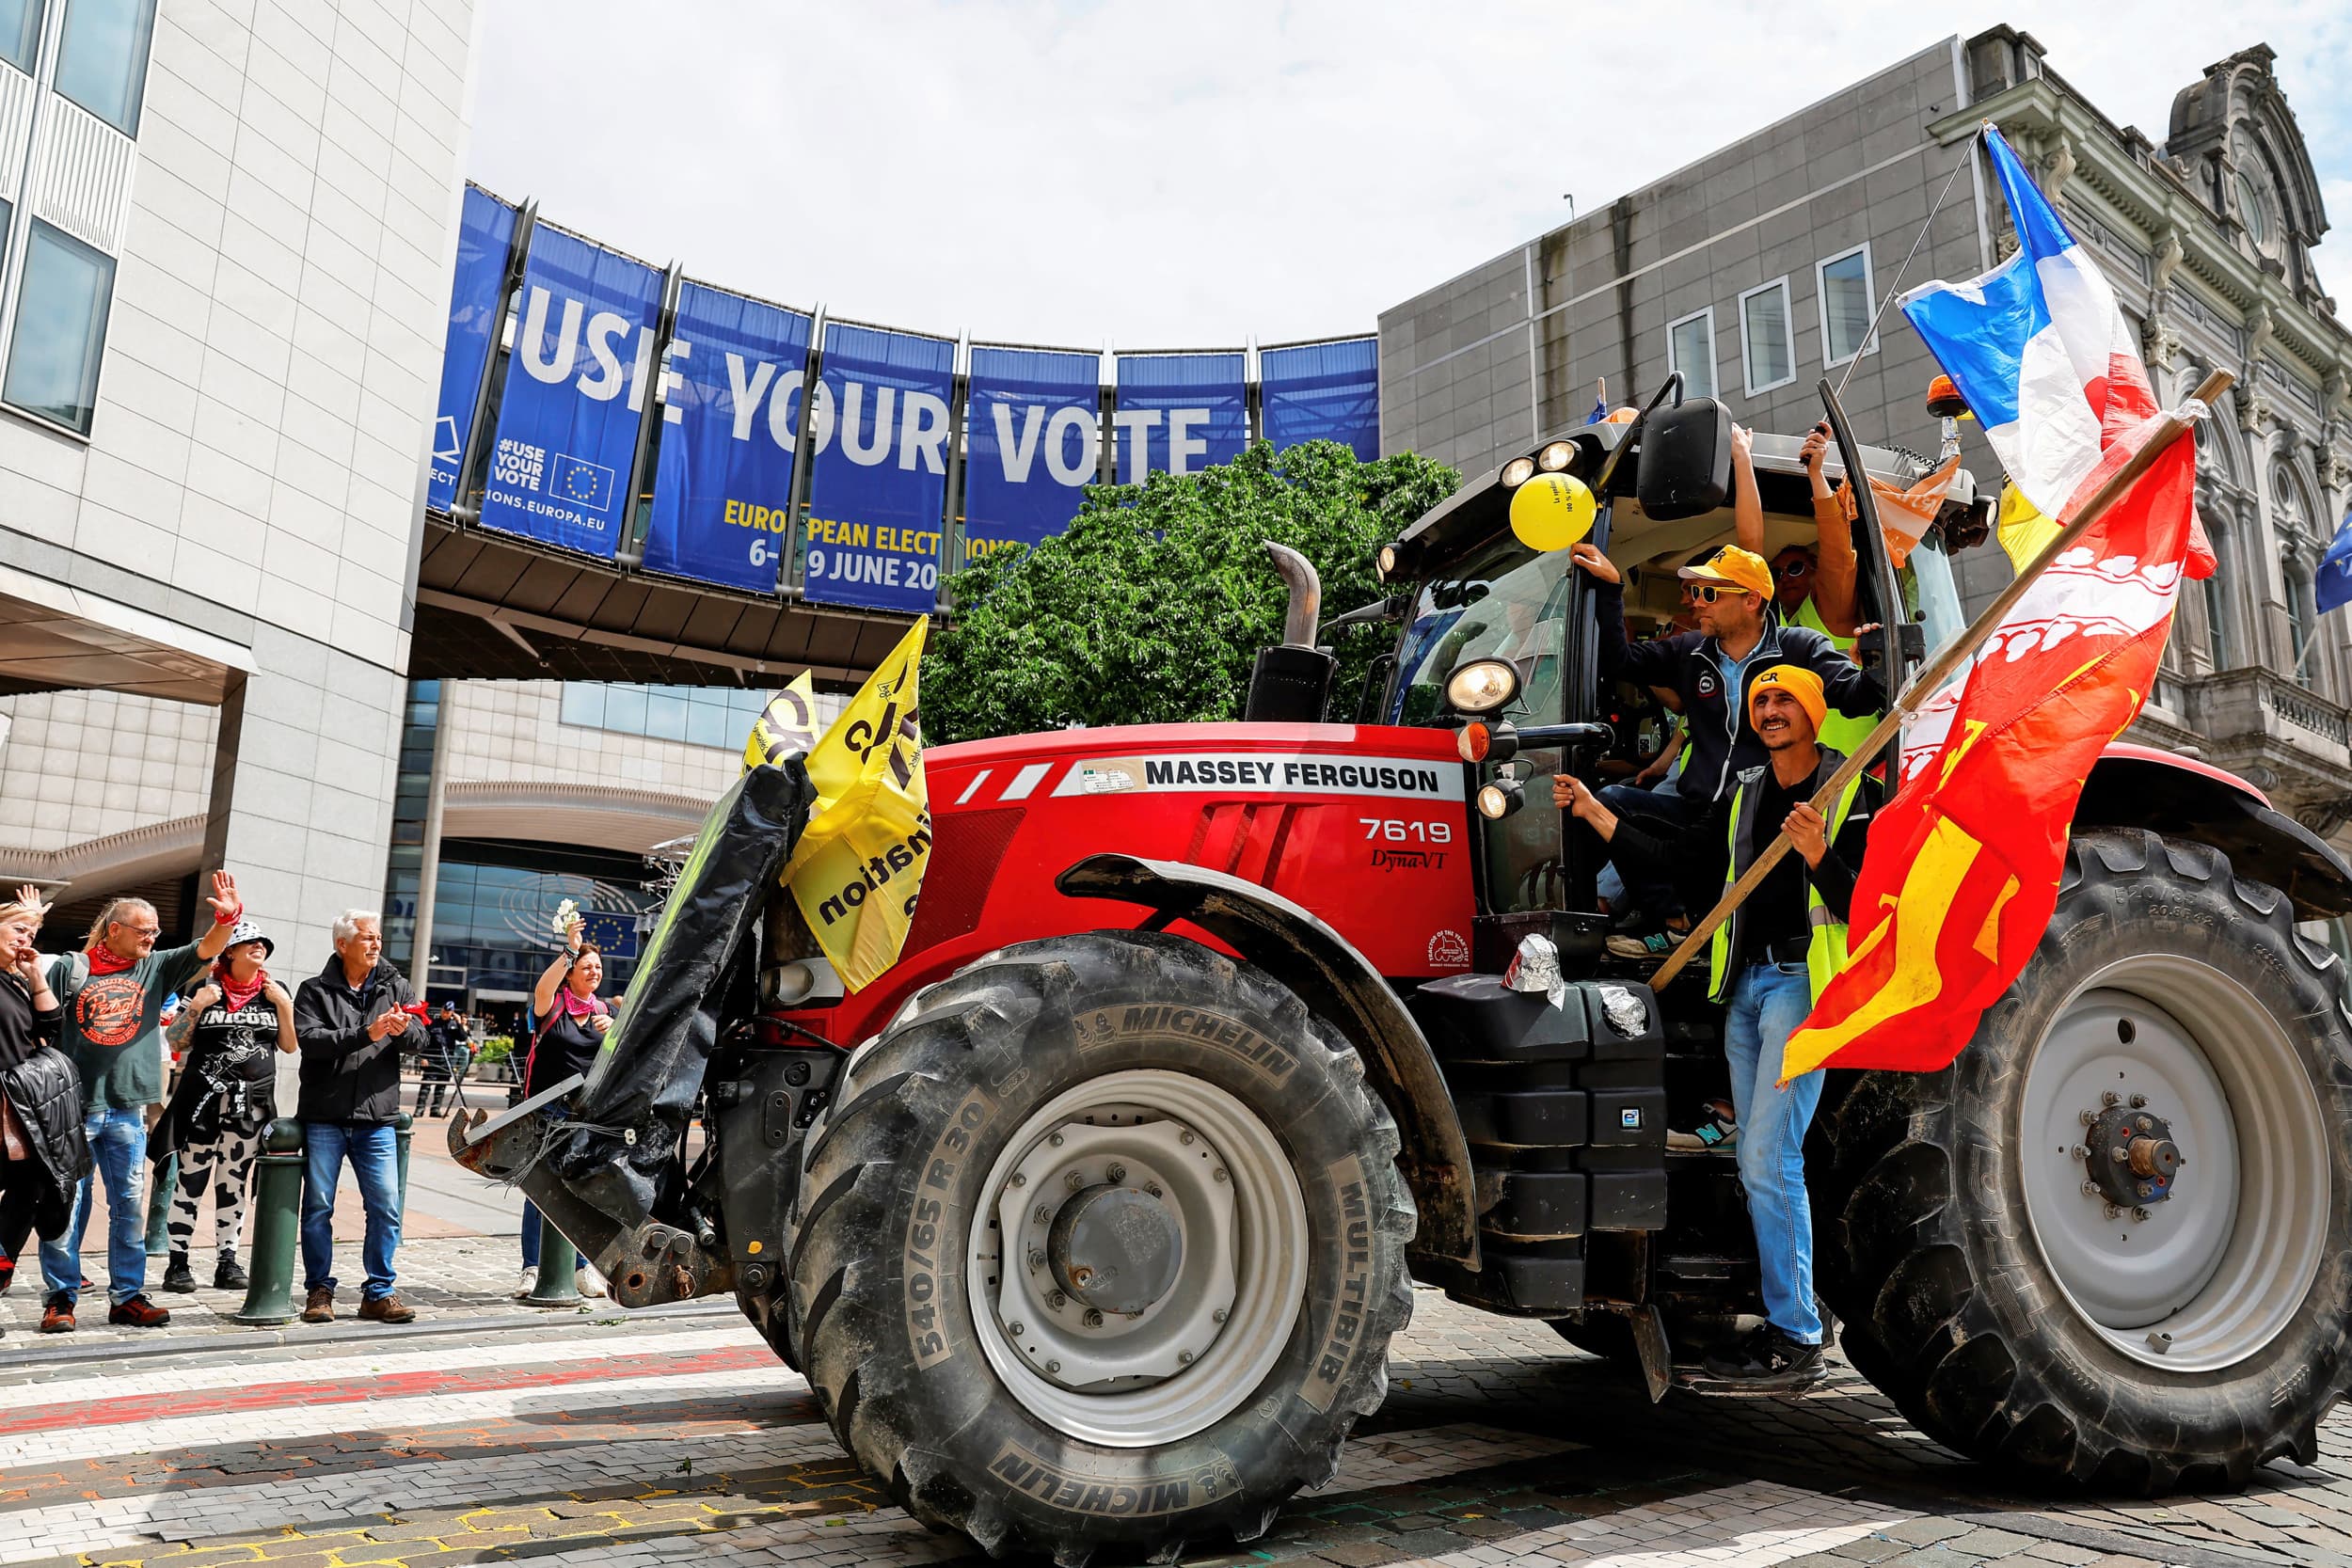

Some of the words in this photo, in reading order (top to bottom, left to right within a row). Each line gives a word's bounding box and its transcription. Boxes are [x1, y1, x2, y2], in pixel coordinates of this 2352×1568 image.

[520, 286, 691, 425] USE
[724, 352, 951, 474] YOUR
[993, 403, 1210, 487] VOTE
[497, 451, 544, 478] YOUR
[499, 438, 546, 462] #USE
[494, 467, 540, 492] VOTE
[829, 551, 899, 587] JUNE
[1760, 672, 1778, 683] CR
[1145, 760, 1274, 784] MASSEY
[1283, 762, 1439, 793] FERGUSON
[1359, 817, 1452, 844] 7619
[1371, 848, 1449, 873] Dyna-VT
[86, 991, 138, 1020] Petrol
[1123, 1006, 1295, 1079] MICHELIN
[943, 1101, 986, 1155] 30
[925, 1157, 956, 1192] R
[908, 1196, 945, 1359] 540/65
[1316, 1180, 1369, 1388] MULTIBIB
[989, 1450, 1189, 1513] MICHELIN
